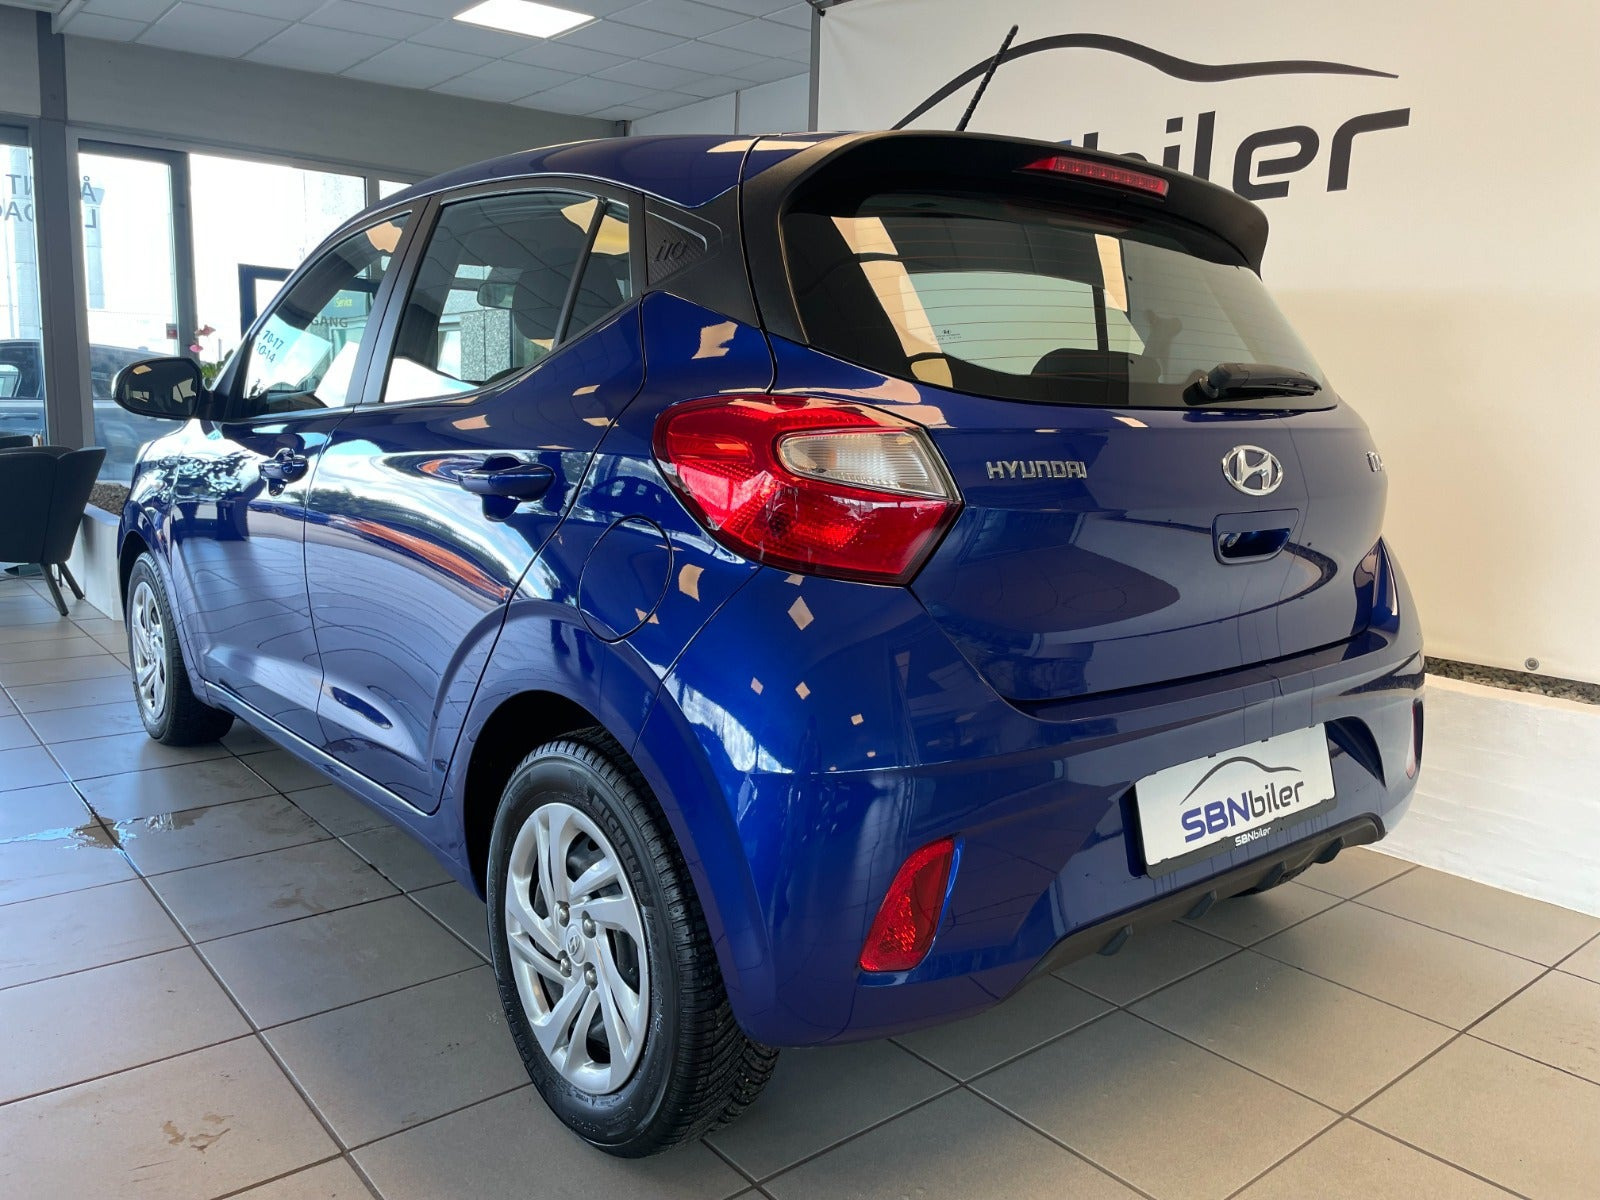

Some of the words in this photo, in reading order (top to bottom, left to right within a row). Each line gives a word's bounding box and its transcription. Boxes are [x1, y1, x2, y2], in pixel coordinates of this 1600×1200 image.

[986, 460, 1088, 480] HYUNDAI
[1181, 780, 1305, 843] SBNbiler
[1234, 826, 1272, 847] SBNbiler
